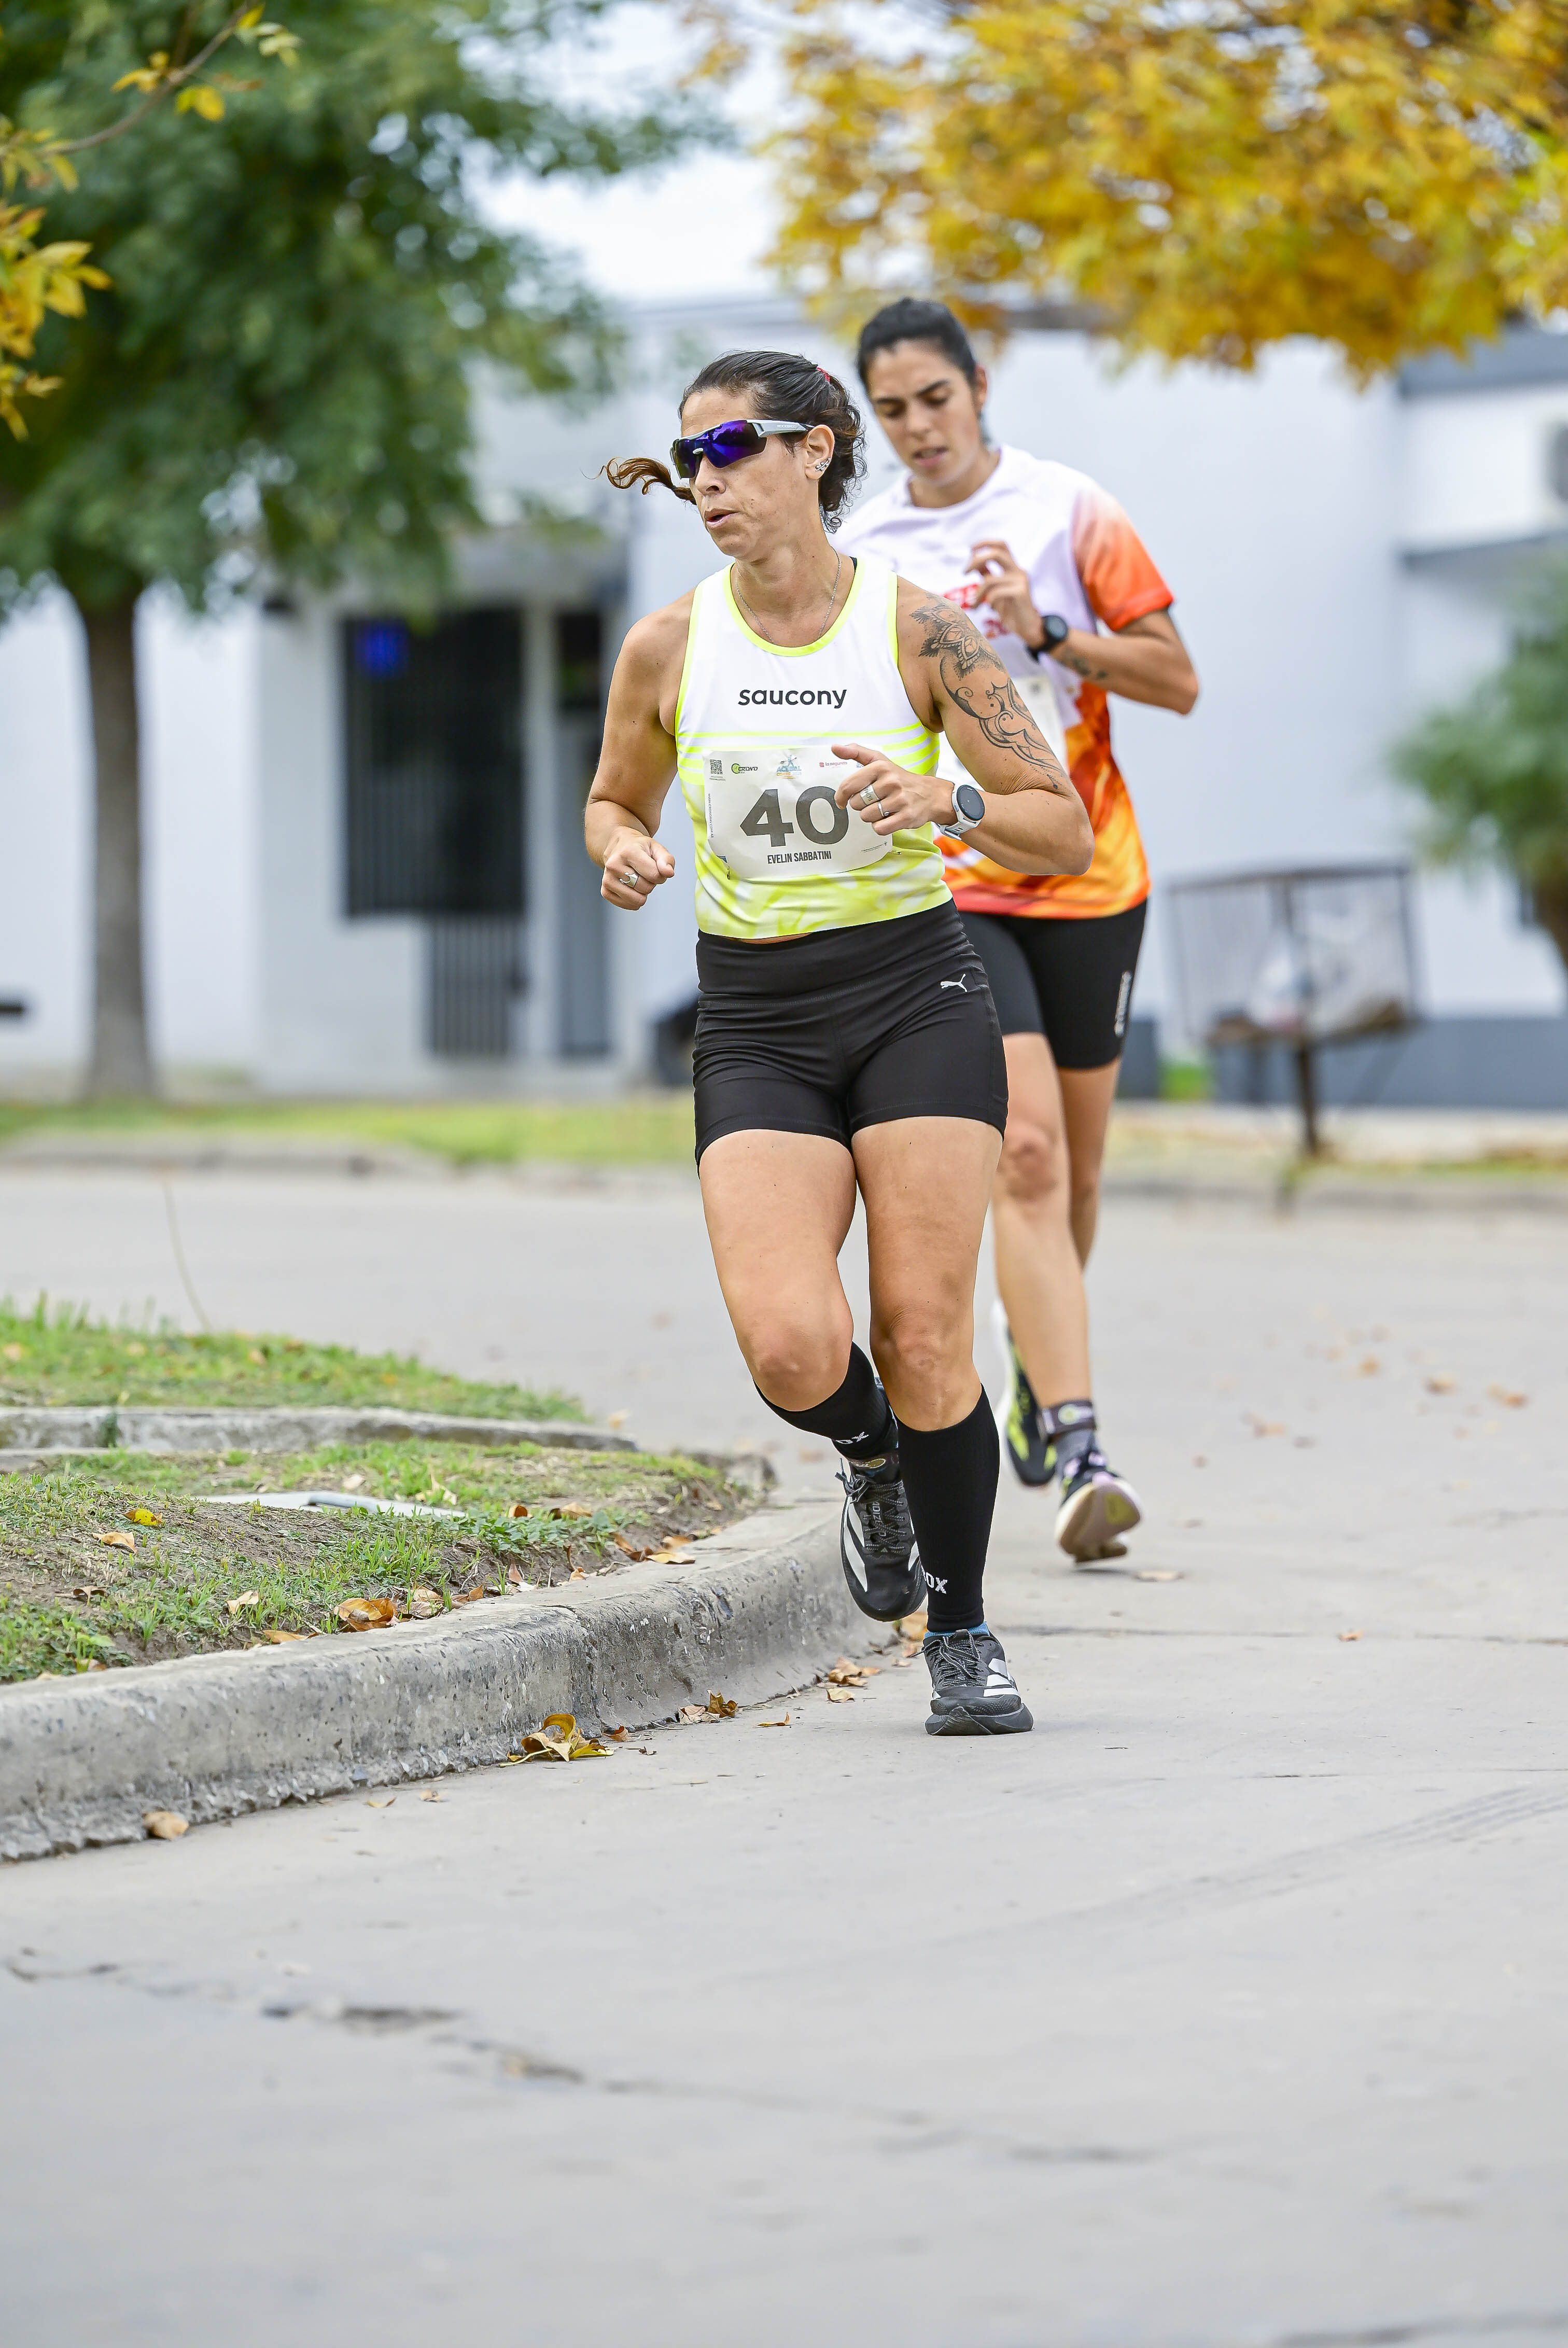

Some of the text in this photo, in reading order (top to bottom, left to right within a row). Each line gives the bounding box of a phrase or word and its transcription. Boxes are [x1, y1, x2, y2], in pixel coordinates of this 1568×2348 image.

[738, 689, 847, 709] saucony
[740, 786, 849, 847] 40
[767, 850, 832, 864] EVELIN SABBATINI
